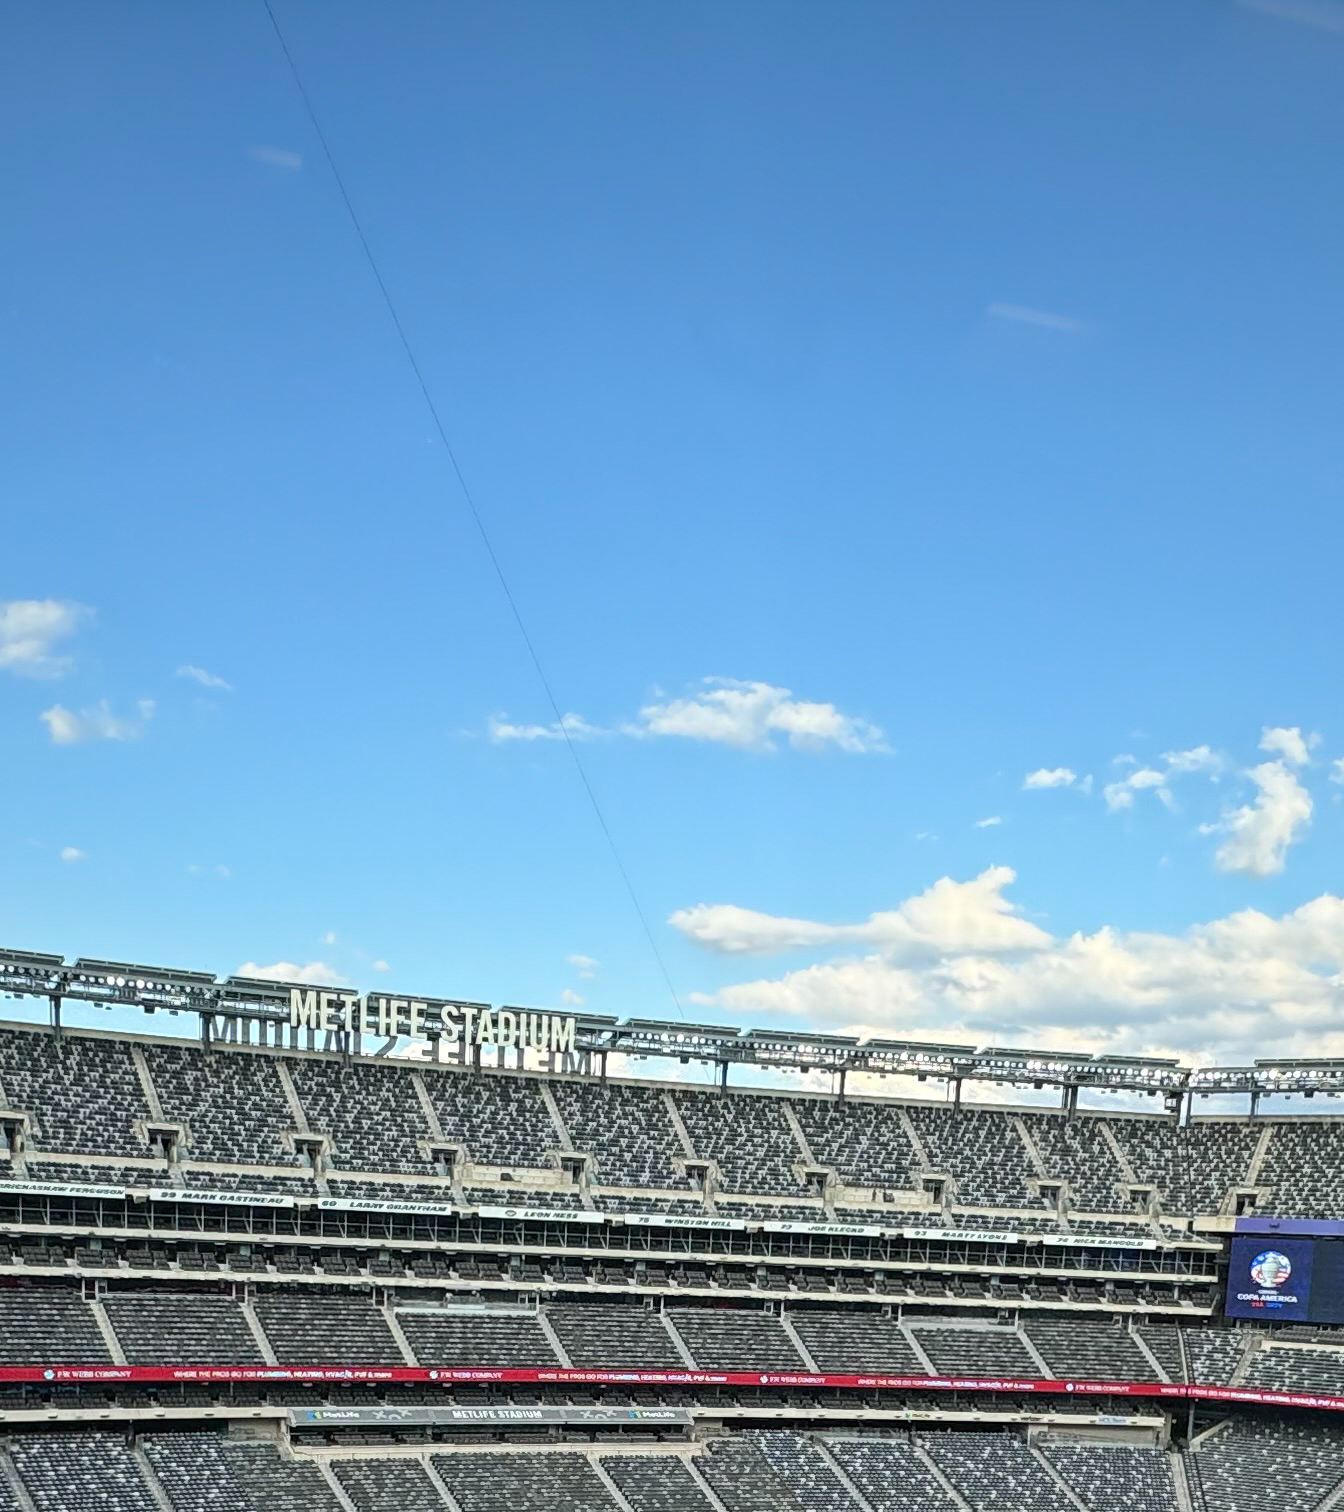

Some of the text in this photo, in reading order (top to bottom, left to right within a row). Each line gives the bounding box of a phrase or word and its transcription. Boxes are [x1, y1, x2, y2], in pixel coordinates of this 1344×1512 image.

[290, 989, 576, 1053] METLIFE STADIUM
[181, 1193, 217, 1201] MARK
[453, 1410, 542, 1418] METLIFE STADIUM
